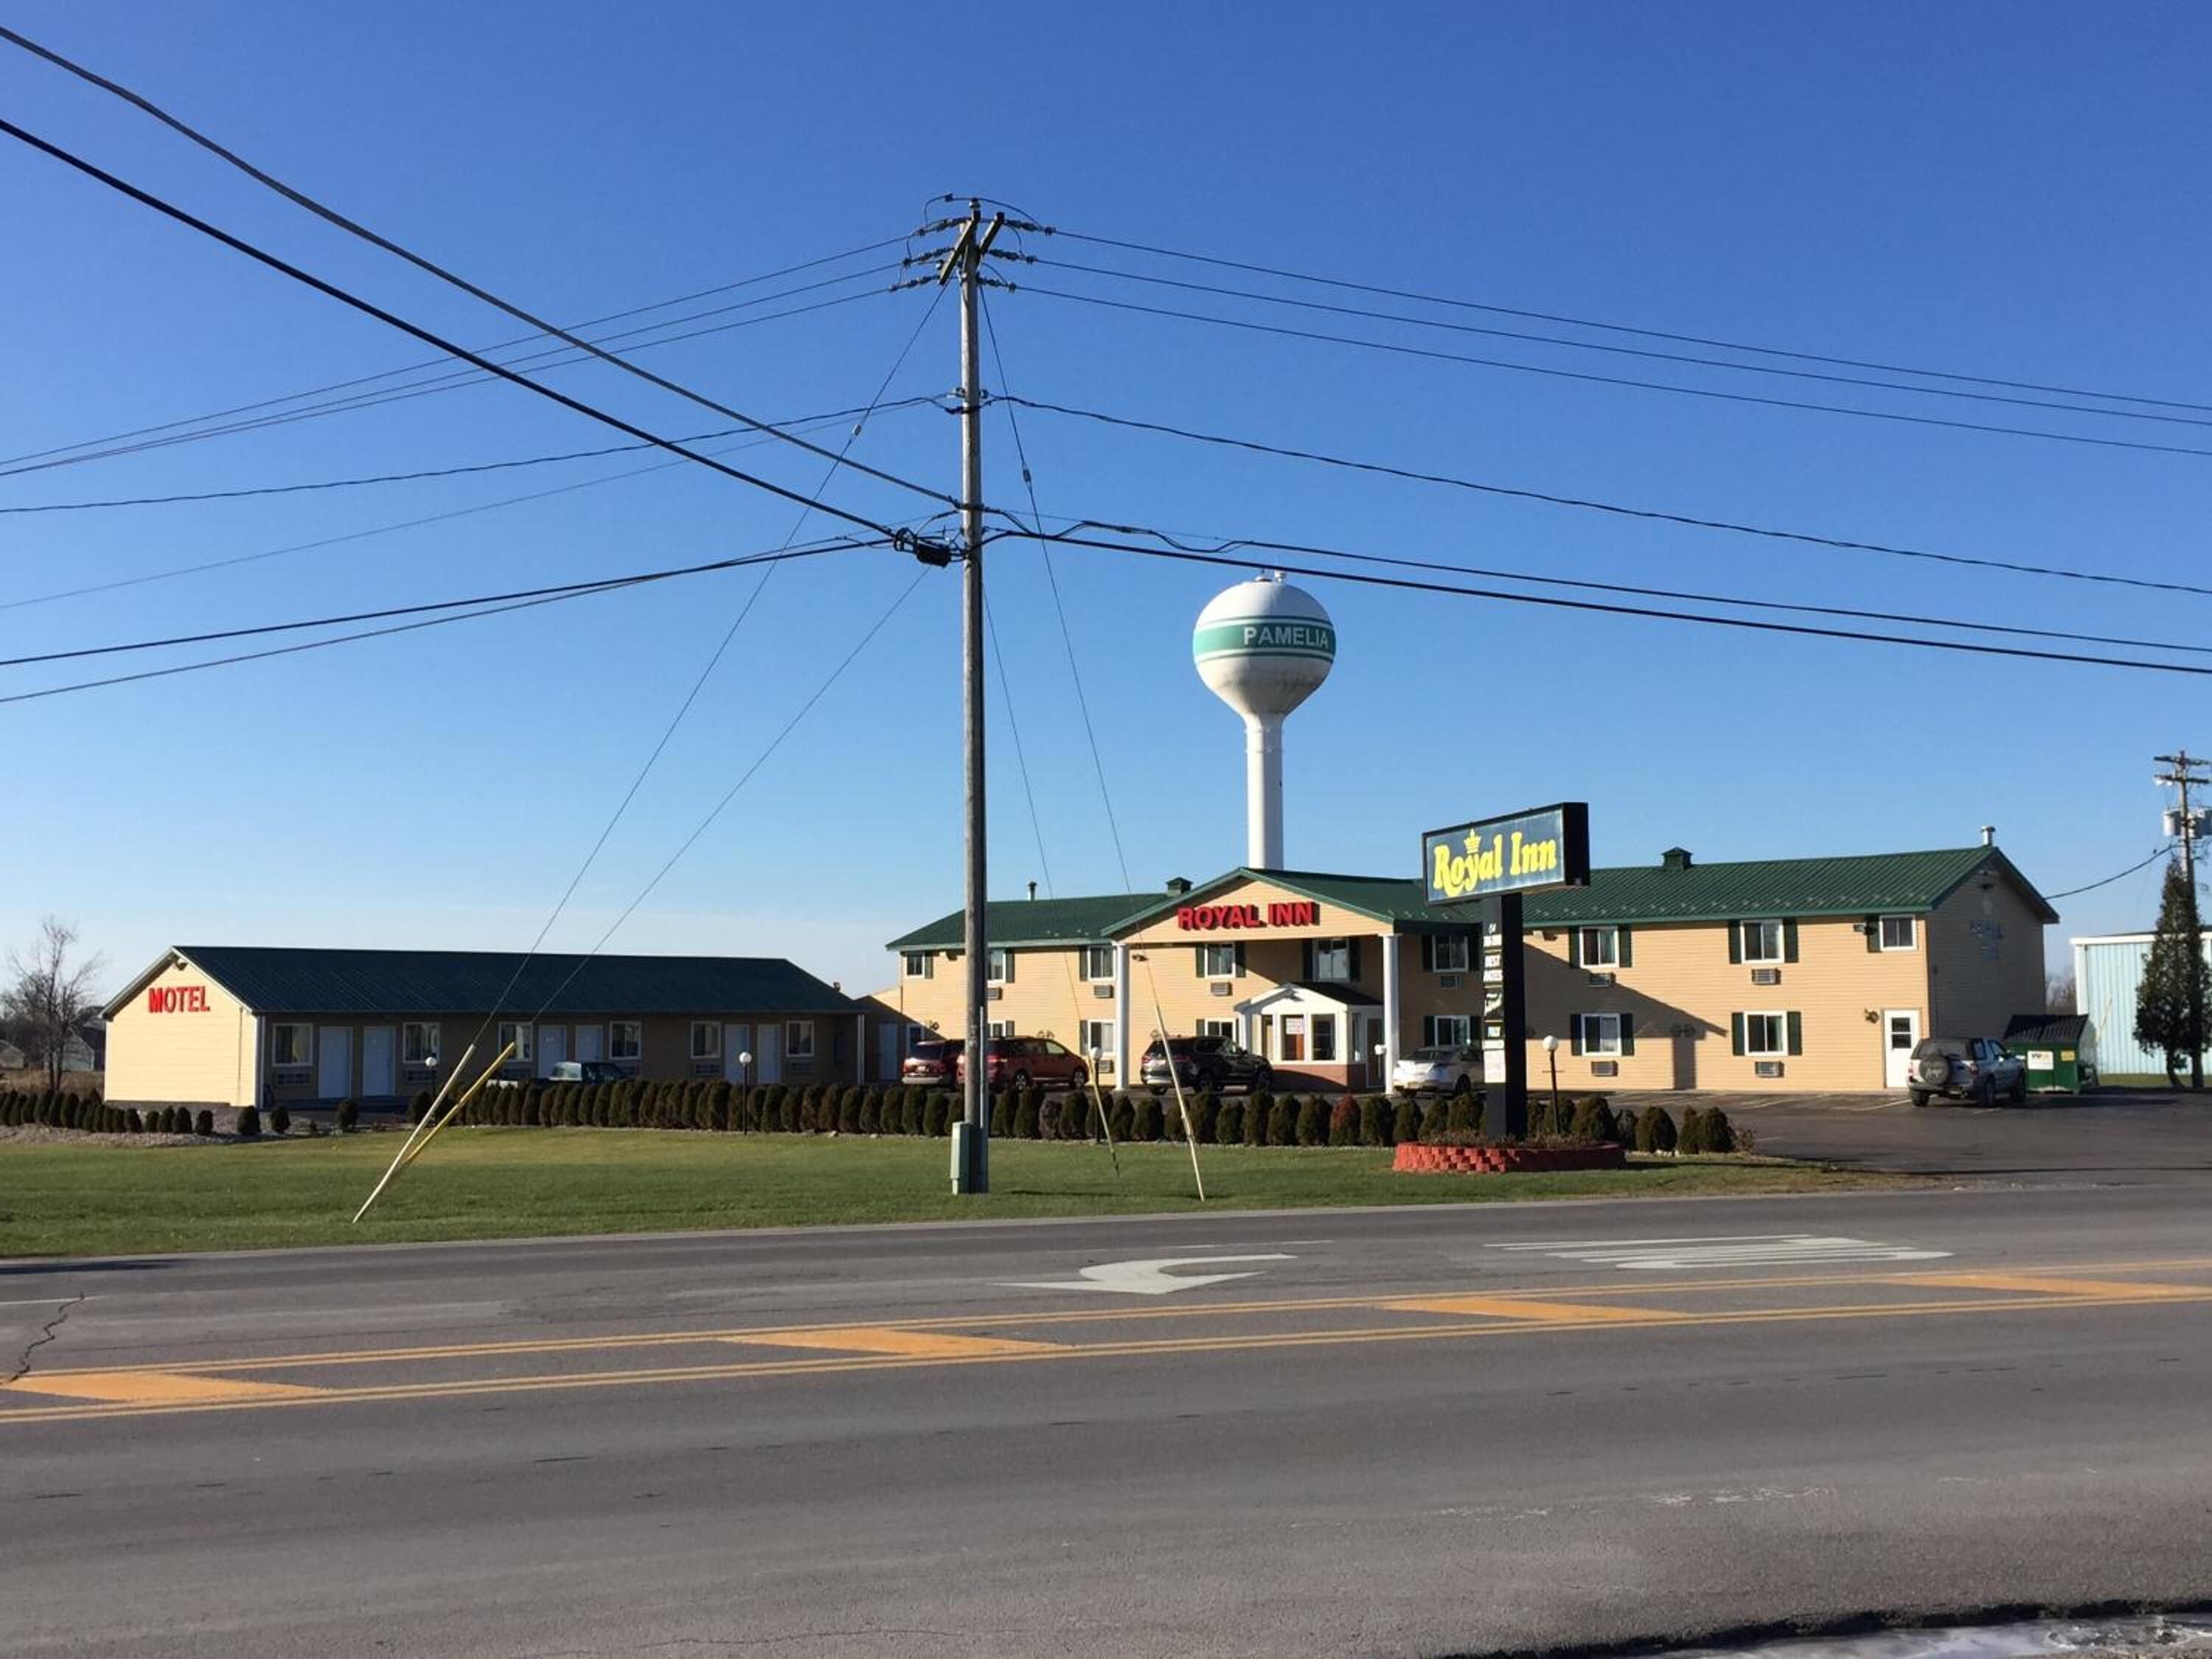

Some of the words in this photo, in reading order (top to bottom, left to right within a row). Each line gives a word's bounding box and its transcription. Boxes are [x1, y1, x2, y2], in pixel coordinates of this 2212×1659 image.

[1243, 627, 1329, 649] PAMELIA
[1433, 834, 1503, 897] Royal
[1509, 831, 1557, 876] Inn
[1178, 904, 1265, 931] ROYAL
[1267, 901, 1318, 926] INN
[149, 986, 211, 1013] MOTEL
